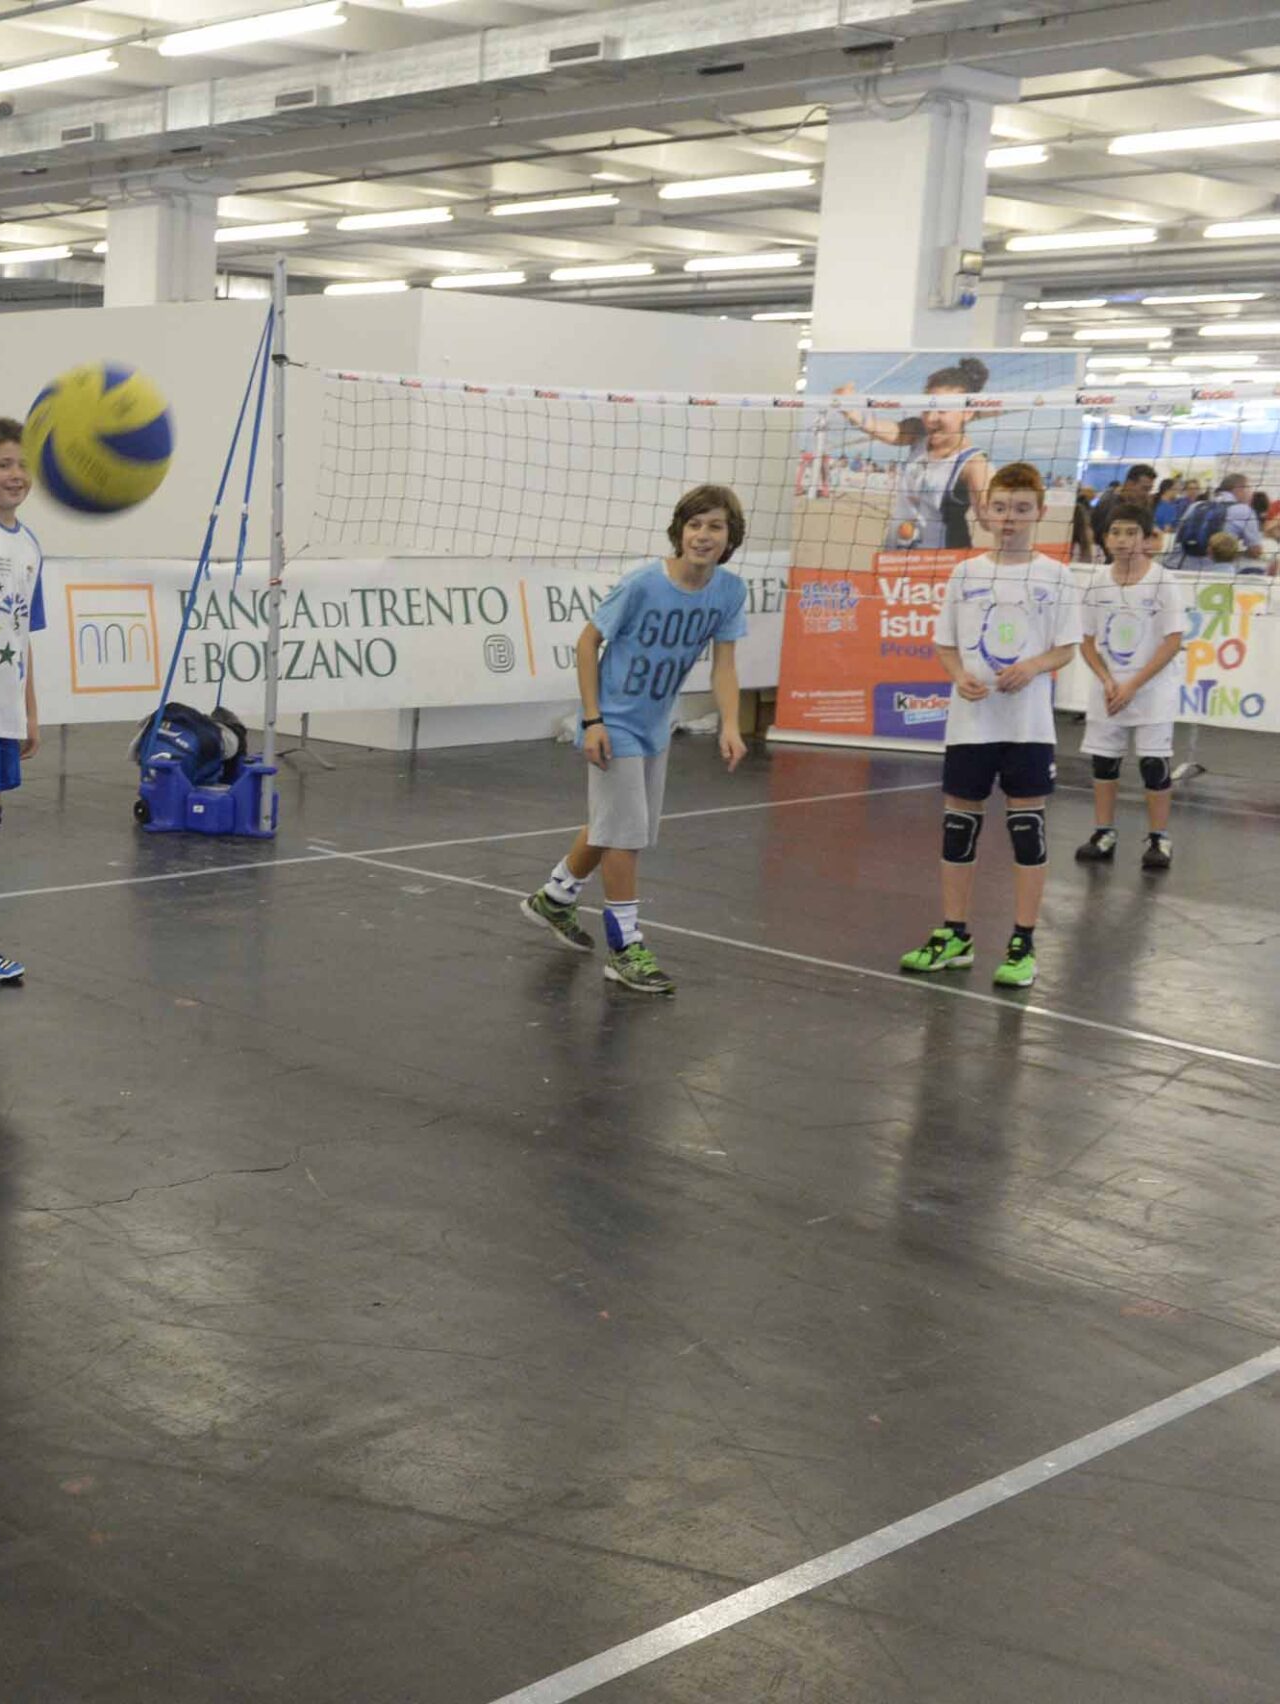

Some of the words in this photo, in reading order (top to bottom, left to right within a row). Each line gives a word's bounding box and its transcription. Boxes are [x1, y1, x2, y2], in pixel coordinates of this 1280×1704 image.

[177, 589, 320, 631] BANCA
[320, 601, 351, 628] DI
[350, 586, 508, 627] TRENTO
[544, 584, 616, 623] BAN
[878, 576, 946, 611] Viag
[638, 607, 722, 649] GOOD
[880, 609, 934, 638] istr
[182, 656, 198, 685] E
[202, 637, 397, 684] BOLZANO
[880, 642, 934, 661] Prog
